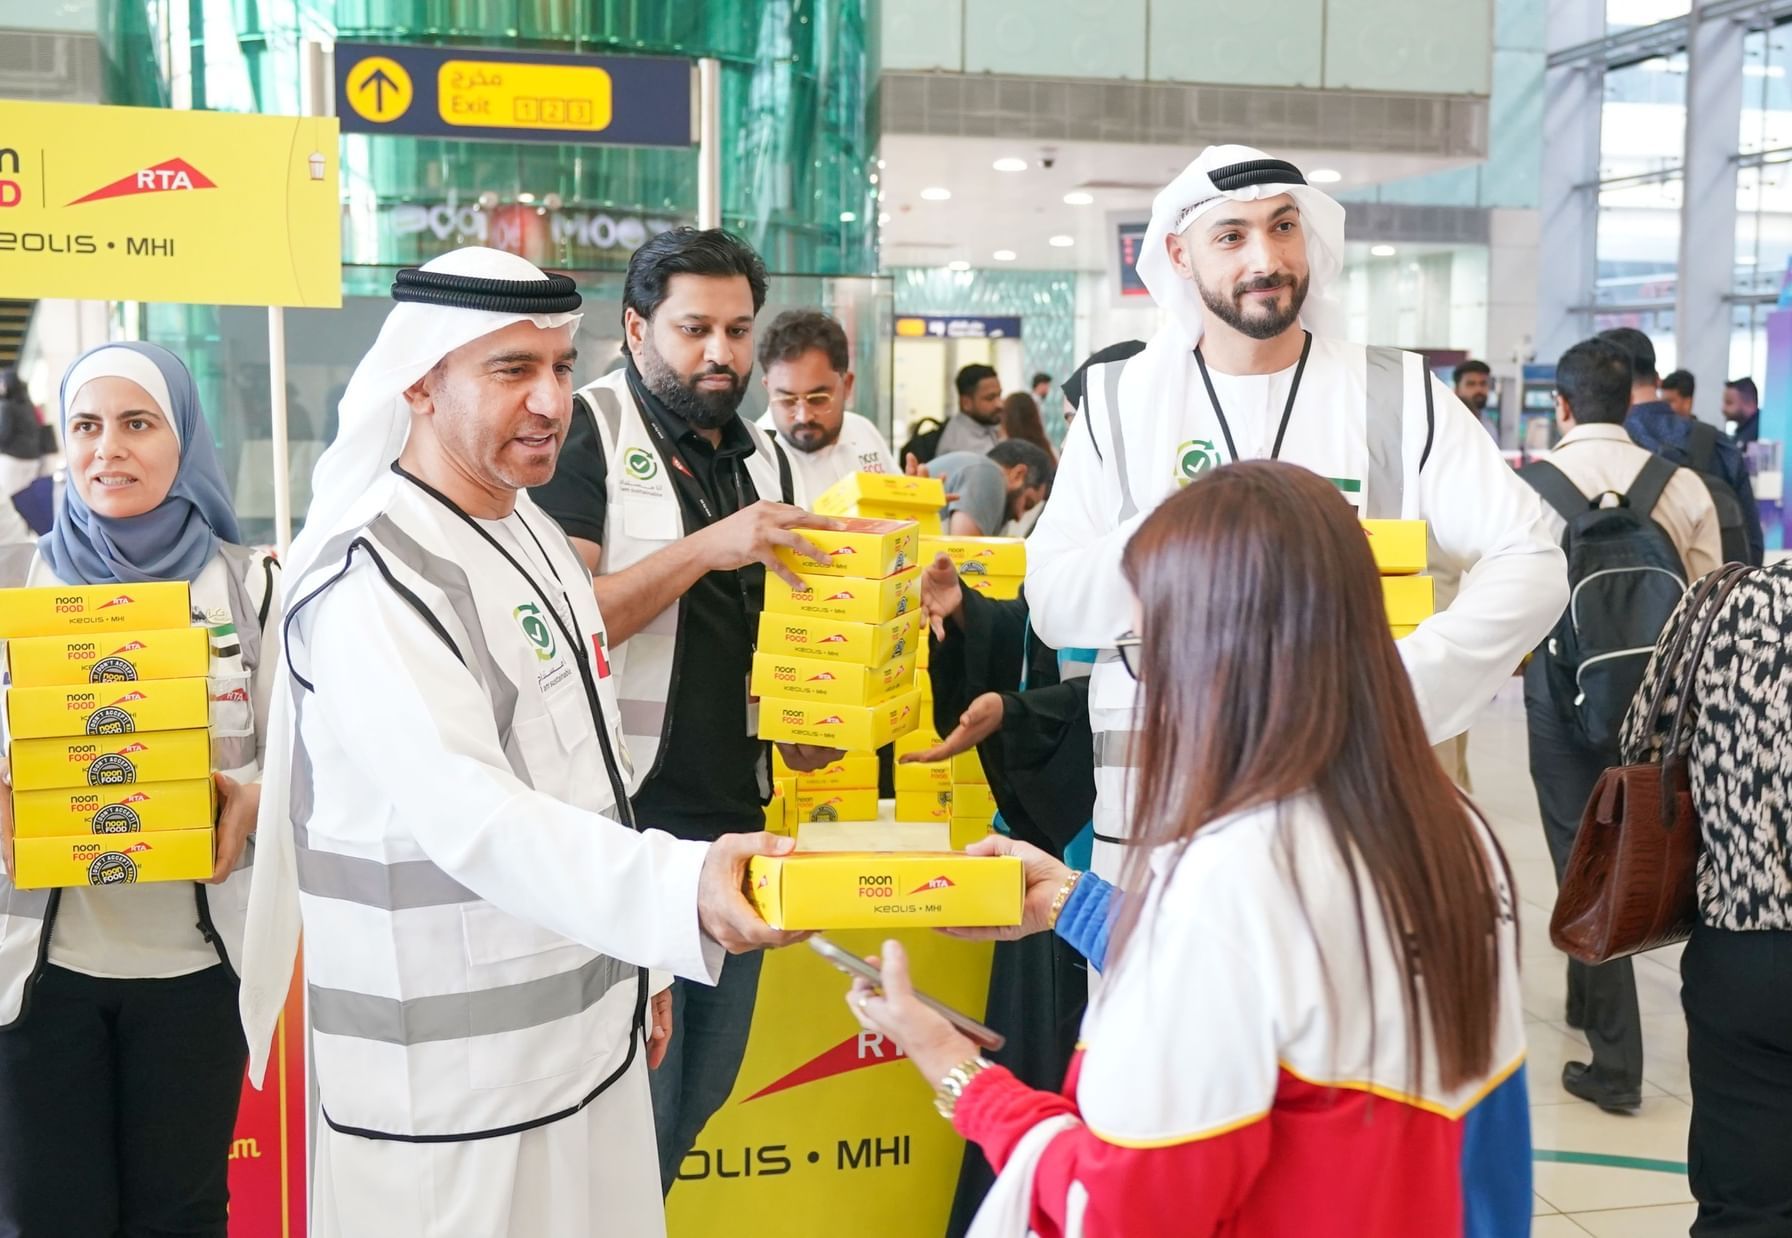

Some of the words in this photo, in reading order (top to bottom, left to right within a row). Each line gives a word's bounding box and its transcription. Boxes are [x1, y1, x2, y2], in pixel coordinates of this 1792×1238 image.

[451, 70, 503, 89] مخرج
[451, 95, 491, 114] Exit
[136, 169, 194, 190] RTA
[126, 237, 174, 256] MHI
[55, 596, 83, 605] noon
[56, 605, 84, 613] FOOD
[785, 627, 808, 635] noon
[785, 635, 808, 643] FOOD
[67, 642, 95, 651] noon
[68, 651, 96, 660] FOOD
[97, 660, 113, 672] DON'T
[115, 660, 135, 678] ACCEPT
[774, 666, 796, 674] noon
[103, 672, 125, 681] noon
[774, 673, 796, 682] FOOD
[66, 693, 95, 701] noon
[67, 701, 95, 711] FOOD
[105, 710, 129, 722] ACCEPT
[782, 709, 804, 717] noon
[782, 717, 804, 726] FOOD
[99, 721, 121, 732] noon
[68, 744, 96, 753] noon
[68, 753, 97, 762] FOOD
[109, 757, 131, 772] ACCEPT
[101, 769, 123, 777] noon
[101, 776, 123, 784] FOOD
[70, 795, 98, 803] noon
[71, 803, 99, 812] FOOD
[114, 807, 136, 822] ACCEPT
[105, 826, 127, 834] FOOD
[73, 844, 100, 853] noon
[107, 855, 130, 867] ACCEPT
[101, 866, 123, 878] noon
[103, 871, 125, 884] FOOD
[859, 874, 893, 886] noon
[928, 879, 949, 889] RTA
[859, 887, 893, 898] FOOD
[925, 905, 942, 913] MHI
[677, 1144, 791, 1181] OLIS
[837, 1135, 910, 1170] MHI
